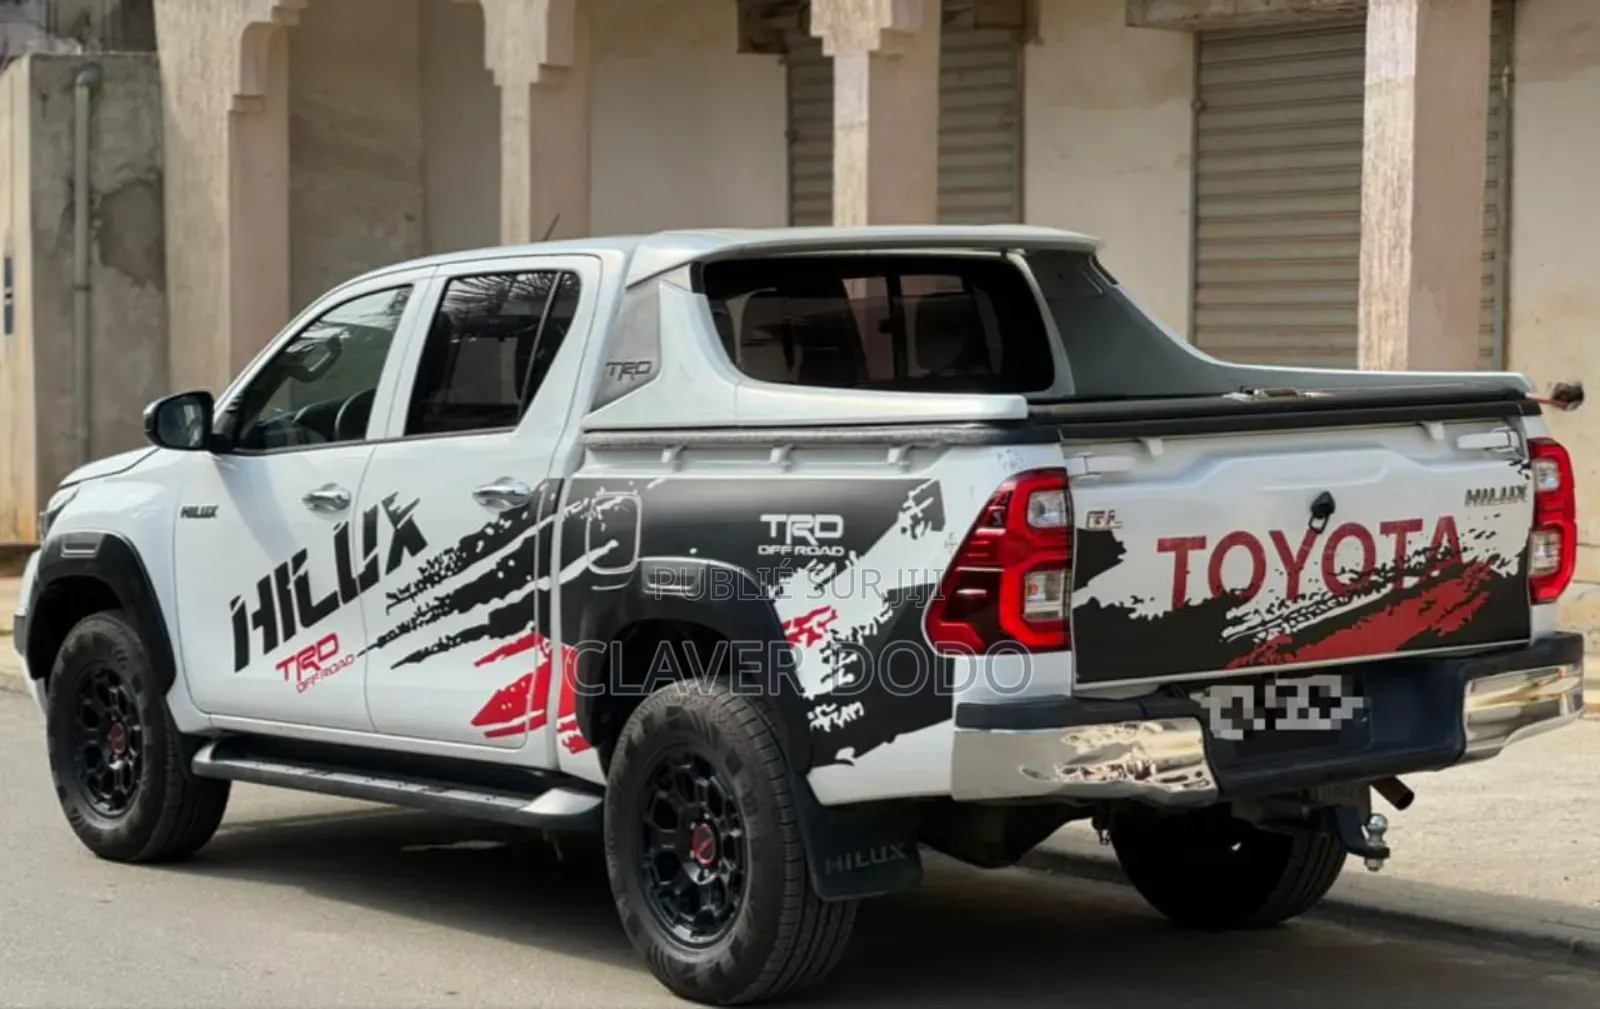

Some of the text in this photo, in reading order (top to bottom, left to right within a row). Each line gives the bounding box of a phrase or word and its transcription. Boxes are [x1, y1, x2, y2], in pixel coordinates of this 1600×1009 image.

[606, 361, 652, 381] TRD
[760, 514, 844, 546] TRD
[758, 544, 845, 556] OFF ROAD
[1157, 516, 1463, 610] TOYOTA
[230, 491, 428, 673] HILUX
[276, 632, 339, 681] TRD
[825, 842, 906, 876] HILUX
